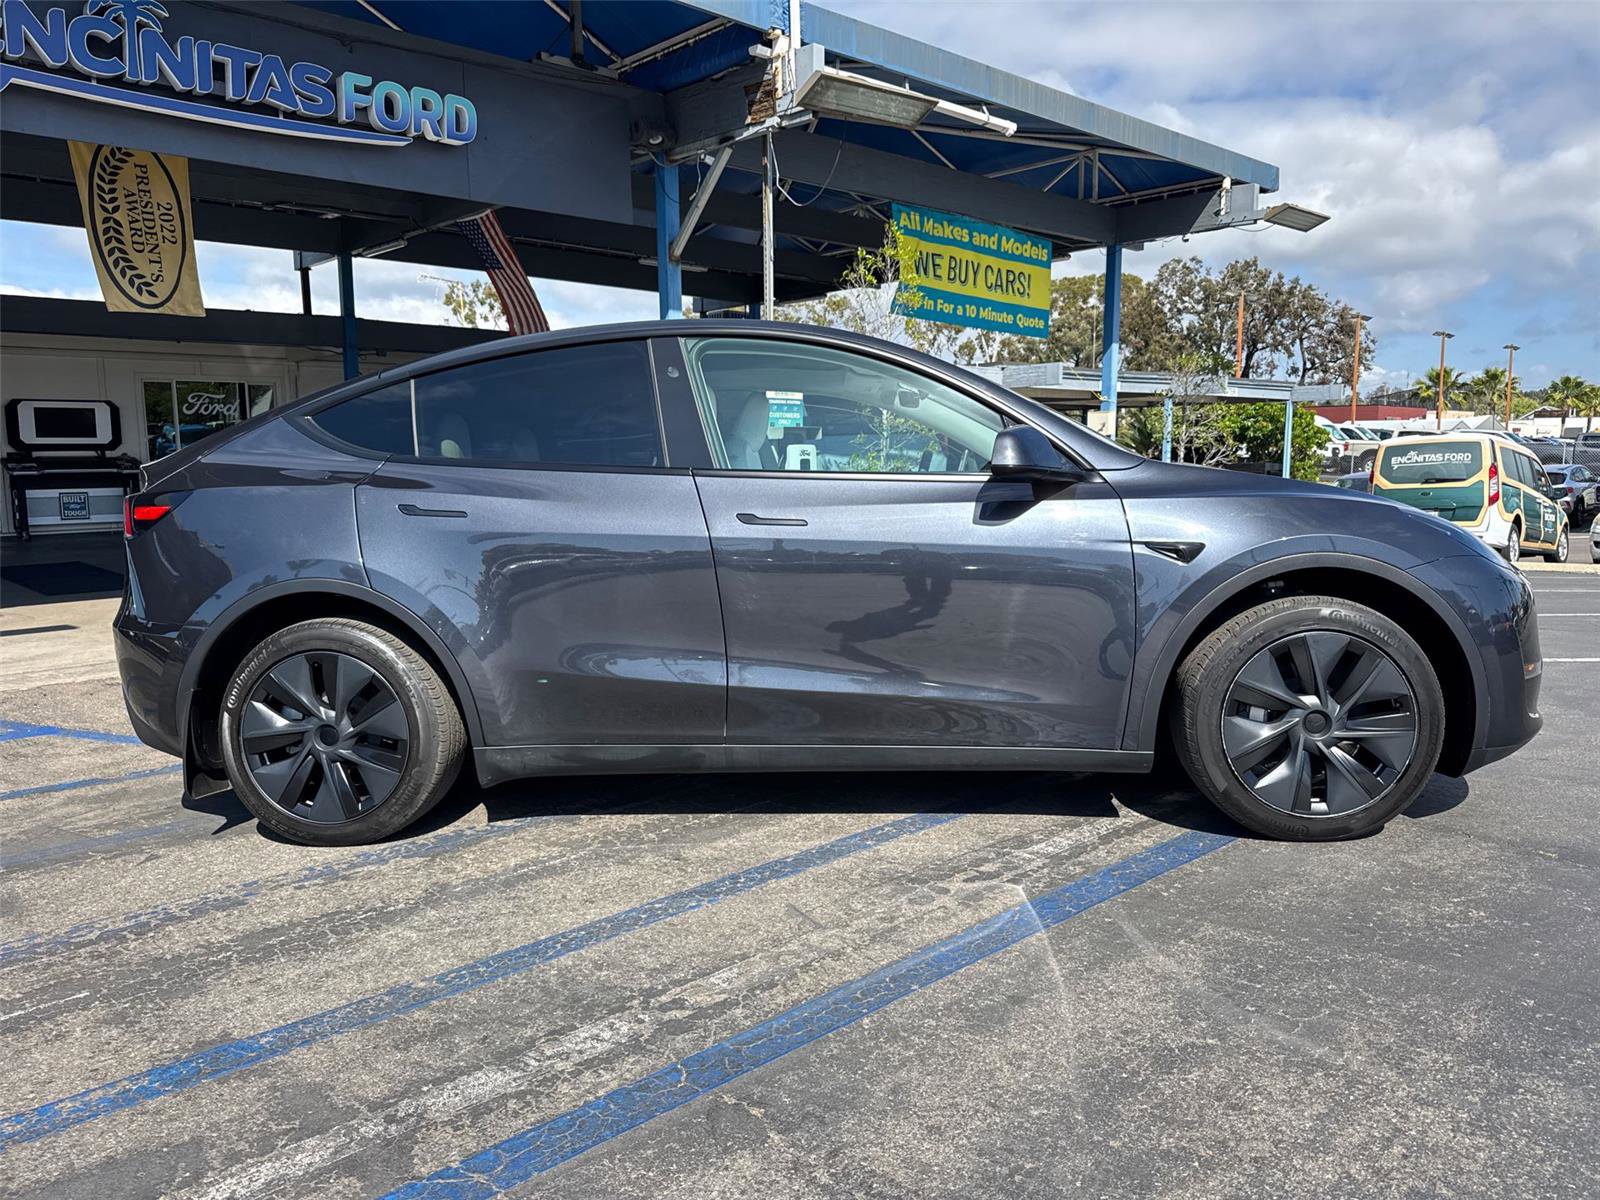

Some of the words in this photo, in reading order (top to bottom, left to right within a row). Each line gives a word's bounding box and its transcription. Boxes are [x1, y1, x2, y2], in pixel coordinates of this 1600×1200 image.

[0, 0, 336, 118] NCINITAS
[337, 71, 478, 146] FORD
[122, 187, 146, 254] AWARD
[133, 162, 165, 283] PRESIDENT'S
[157, 202, 178, 245] 2022
[900, 211, 921, 231] All
[922, 218, 969, 243] Makes
[972, 232, 998, 250] and
[1001, 236, 1048, 262] Models
[914, 250, 944, 281] WE
[947, 255, 980, 288] BUY
[984, 264, 1031, 299] CARS!
[937, 299, 954, 315] For
[956, 304, 963, 316] a
[966, 304, 977, 318] 10
[979, 308, 1013, 325] Minute
[1016, 314, 1045, 329] Quote
[182, 392, 240, 415] Ford
[1391, 452, 1443, 465] ENCINITAS
[1445, 453, 1472, 461] FORD
